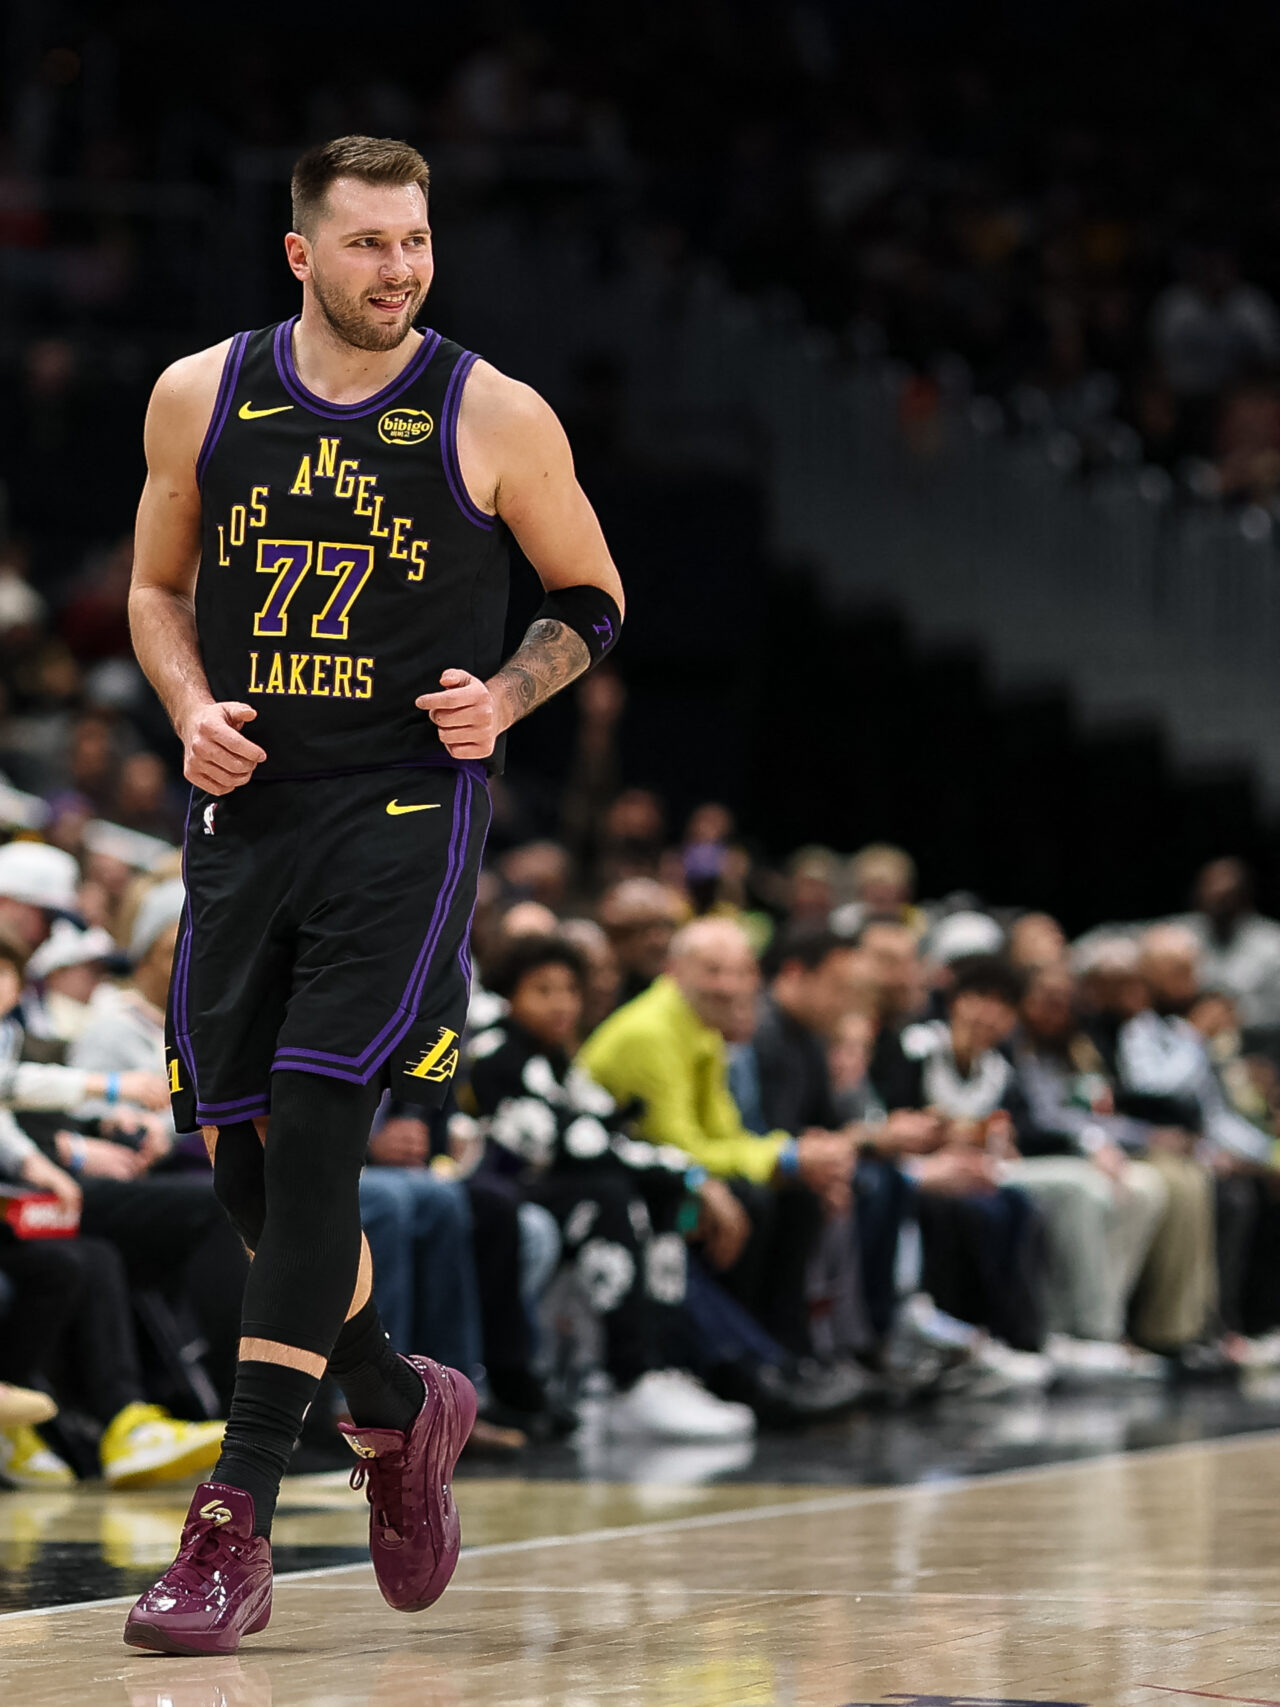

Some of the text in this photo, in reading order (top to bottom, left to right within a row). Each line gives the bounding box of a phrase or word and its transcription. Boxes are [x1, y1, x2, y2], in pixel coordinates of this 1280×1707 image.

[383, 417, 431, 436] bibigo
[218, 436, 430, 582] LOS ANGELES
[253, 538, 375, 640] 77
[248, 651, 375, 699] LAKERS
